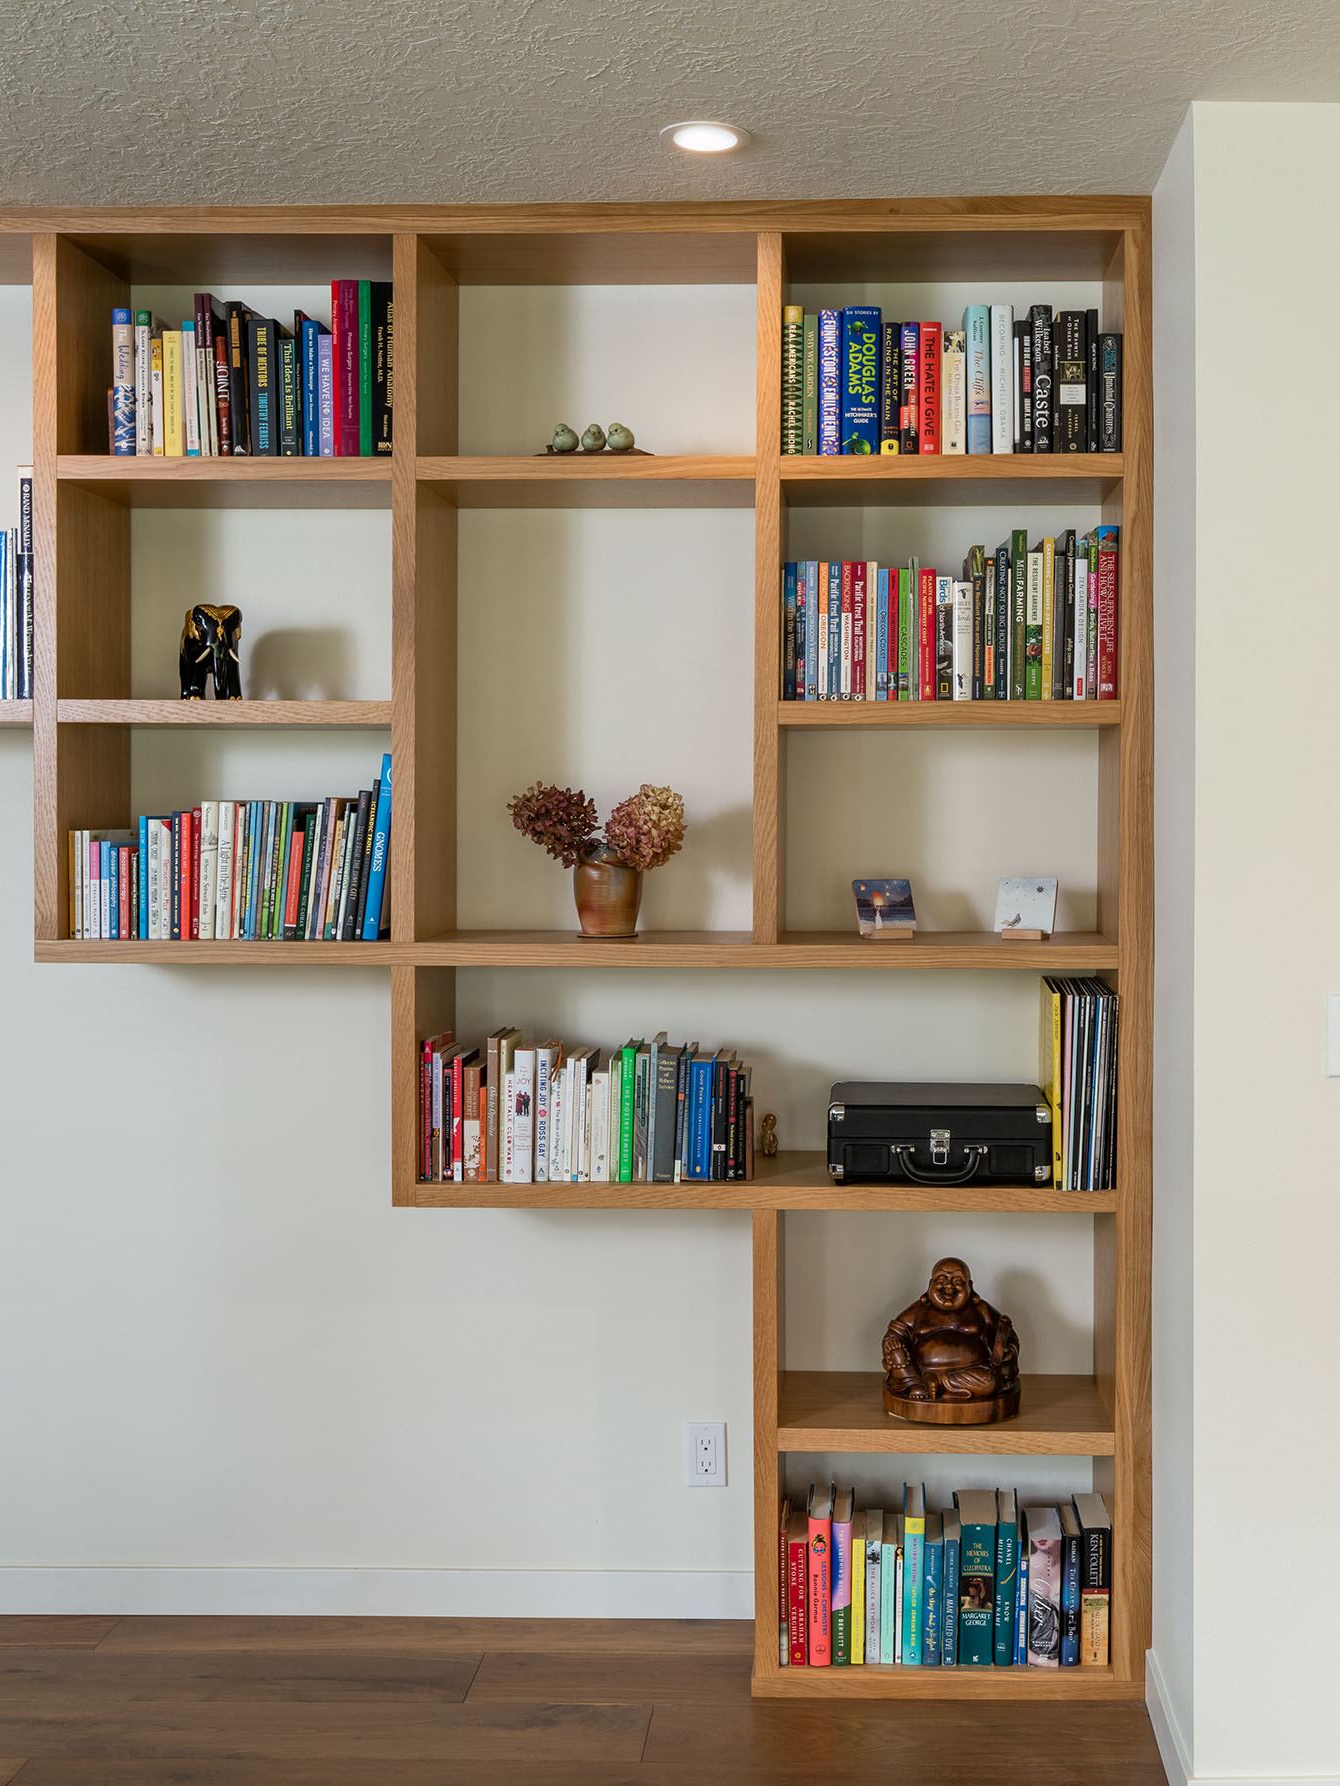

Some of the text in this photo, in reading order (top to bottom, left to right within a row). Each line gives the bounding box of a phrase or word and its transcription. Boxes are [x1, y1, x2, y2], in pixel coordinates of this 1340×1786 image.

[387, 326, 393, 334] of
[1035, 319, 1043, 362] Wilkerson
[1043, 328, 1051, 353] Isabel
[116, 329, 129, 379] The Wedding
[322, 359, 329, 372] WE
[788, 344, 796, 383] AMERICANS
[807, 351, 814, 363] WE
[904, 330, 915, 389] JOHN GREEN
[284, 365, 292, 383] Idea
[824, 320, 836, 441] FUNNY STORY EMILY HENRY
[848, 342, 862, 394] ADAMS
[862, 333, 875, 403] DOUGLAS
[886, 365, 891, 374] IN
[972, 350, 984, 395] The Cliffs
[216, 362, 229, 400] JOINT
[257, 328, 268, 449] TRIBE OF MENTORS TIMOTHY FERRISS
[385, 370, 393, 407] Anatomy
[925, 337, 934, 435] THE HATE U GIVE
[893, 389, 898, 400] OF
[1036, 375, 1051, 428] Caste
[285, 395, 293, 429] Brilliant
[940, 580, 948, 603] Birds
[1100, 598, 1107, 608] TO
[854, 581, 863, 635] Pacific Crest Trail
[999, 605, 1005, 613] SO
[1100, 632, 1106, 641] IT
[219, 847, 230, 857] Light
[373, 832, 385, 872] GNOMES
[221, 873, 229, 883] the
[222, 863, 229, 871] in
[109, 877, 117, 907] philosophy
[219, 885, 229, 902] Attic
[539, 1060, 547, 1091] INCITING
[539, 1093, 547, 1106] JOY
[538, 1143, 546, 1157] GAY
[1090, 1535, 1099, 1586] KEN FOLLETT
[946, 1599, 956, 1613] MAN
[996, 1595, 1001, 1605] MY
[1034, 1577, 1052, 1627] Amber
[946, 1615, 956, 1636] CALLED
[946, 1639, 955, 1650] OVE
